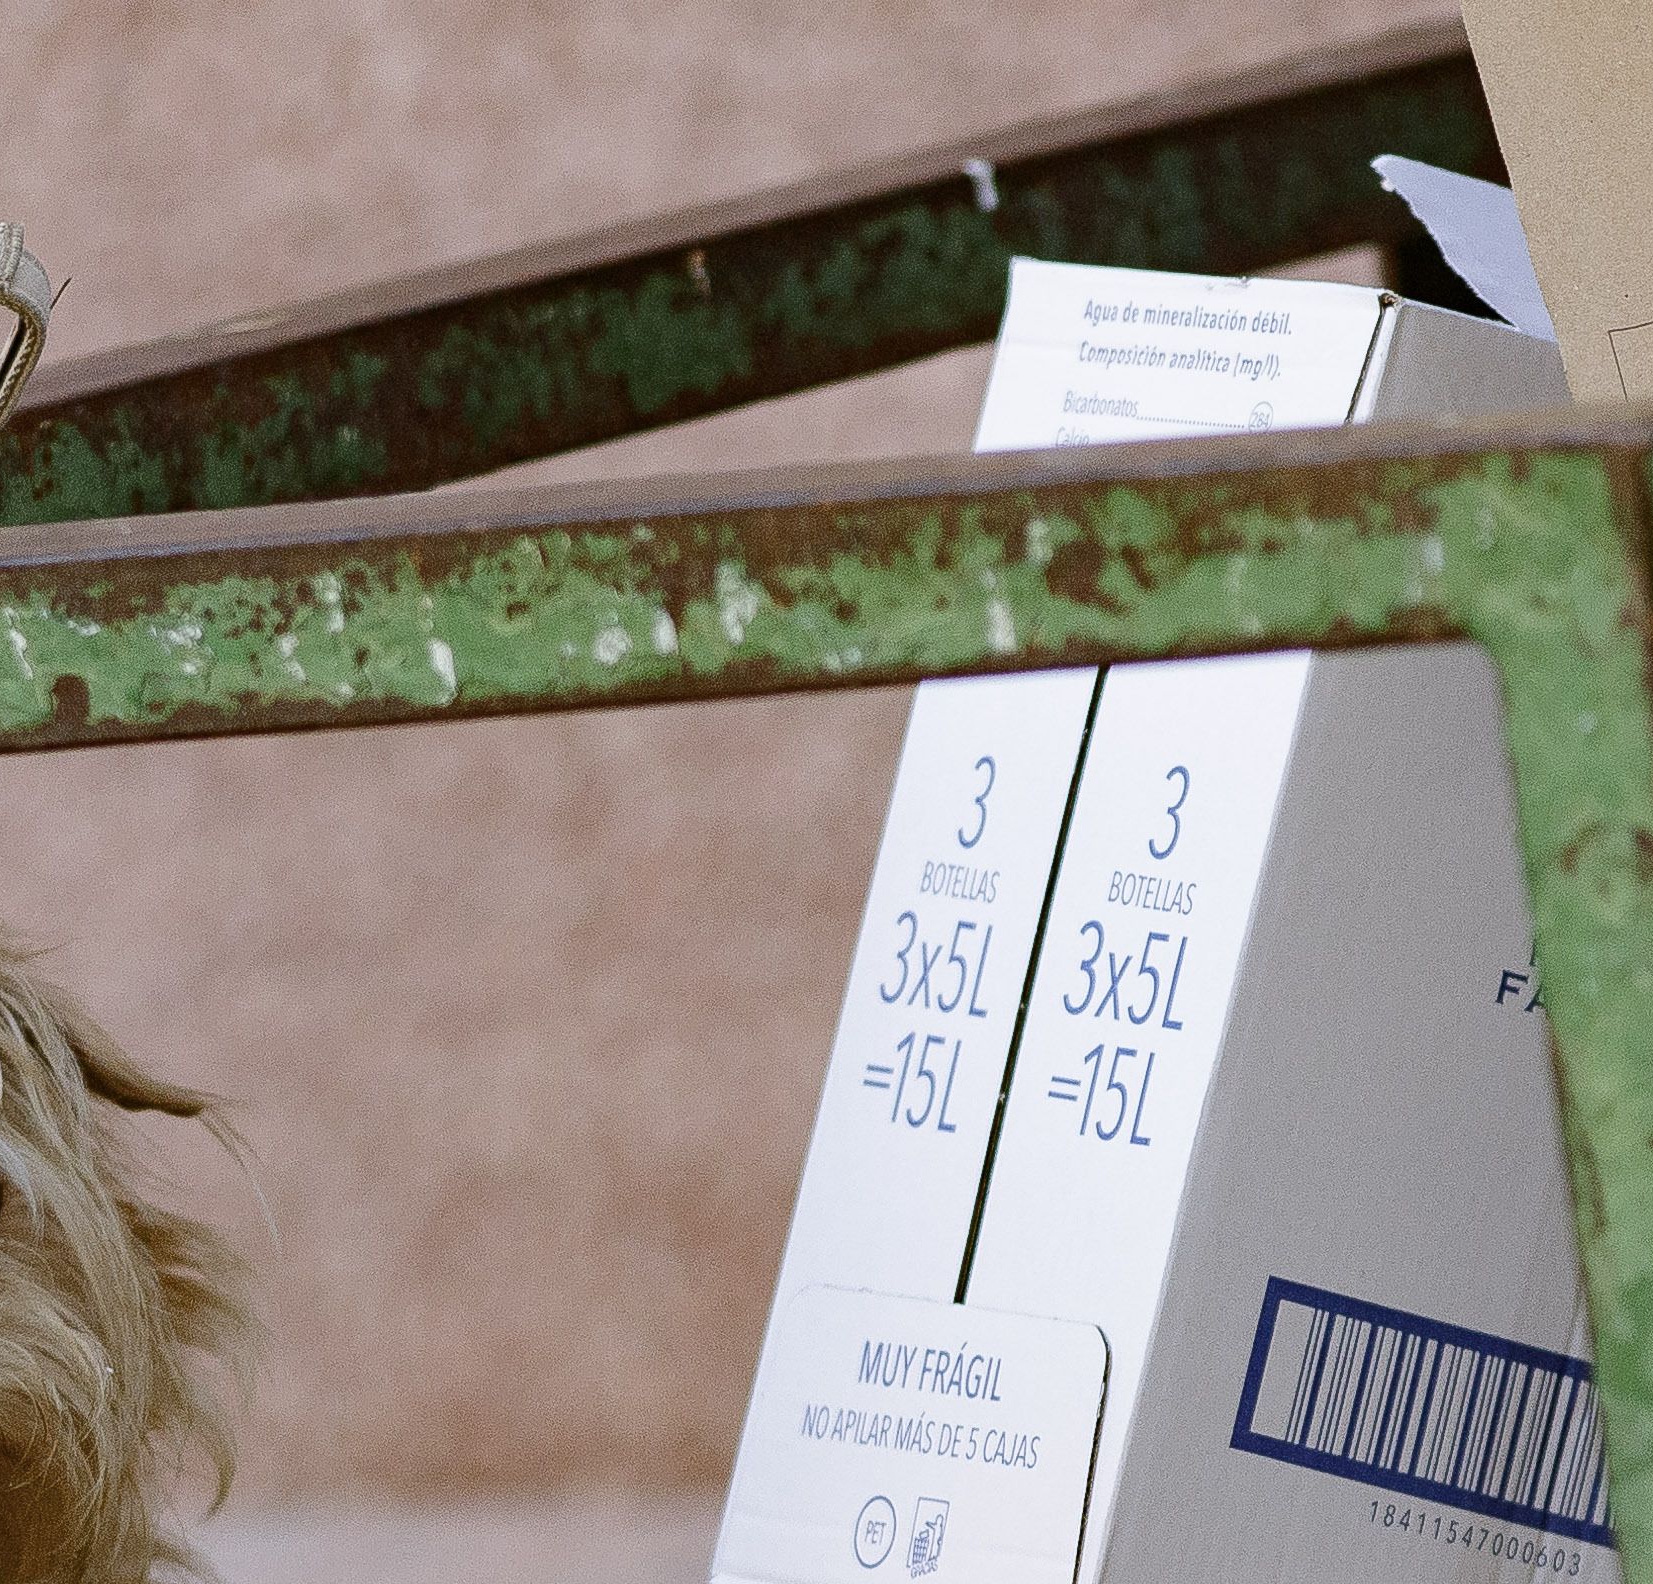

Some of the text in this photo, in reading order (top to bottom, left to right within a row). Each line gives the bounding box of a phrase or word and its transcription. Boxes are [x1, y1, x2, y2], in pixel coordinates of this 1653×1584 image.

[1084, 298, 1292, 335] Agua de mineralización débil.
[1079, 340, 1165, 369] Composición
[1170, 348, 1230, 372] analítica
[958, 755, 996, 849] 3
[1148, 765, 1190, 861] 3
[920, 859, 998, 905] BOTELLAS
[1108, 869, 1196, 916] BOTELLAS
[880, 910, 994, 1019] 3x5L
[1062, 918, 1189, 1031] 3x5L
[863, 1030, 962, 1134] =15L
[1048, 1043, 1155, 1147] =15L
[858, 1340, 1002, 1401] MUY FRÁGIL
[800, 1404, 1041, 1469] NO APILAR MÁS DE 5 CAJAS
[865, 1520, 887, 1545] PET
[1370, 1500, 1582, 1577] 18411547000603
